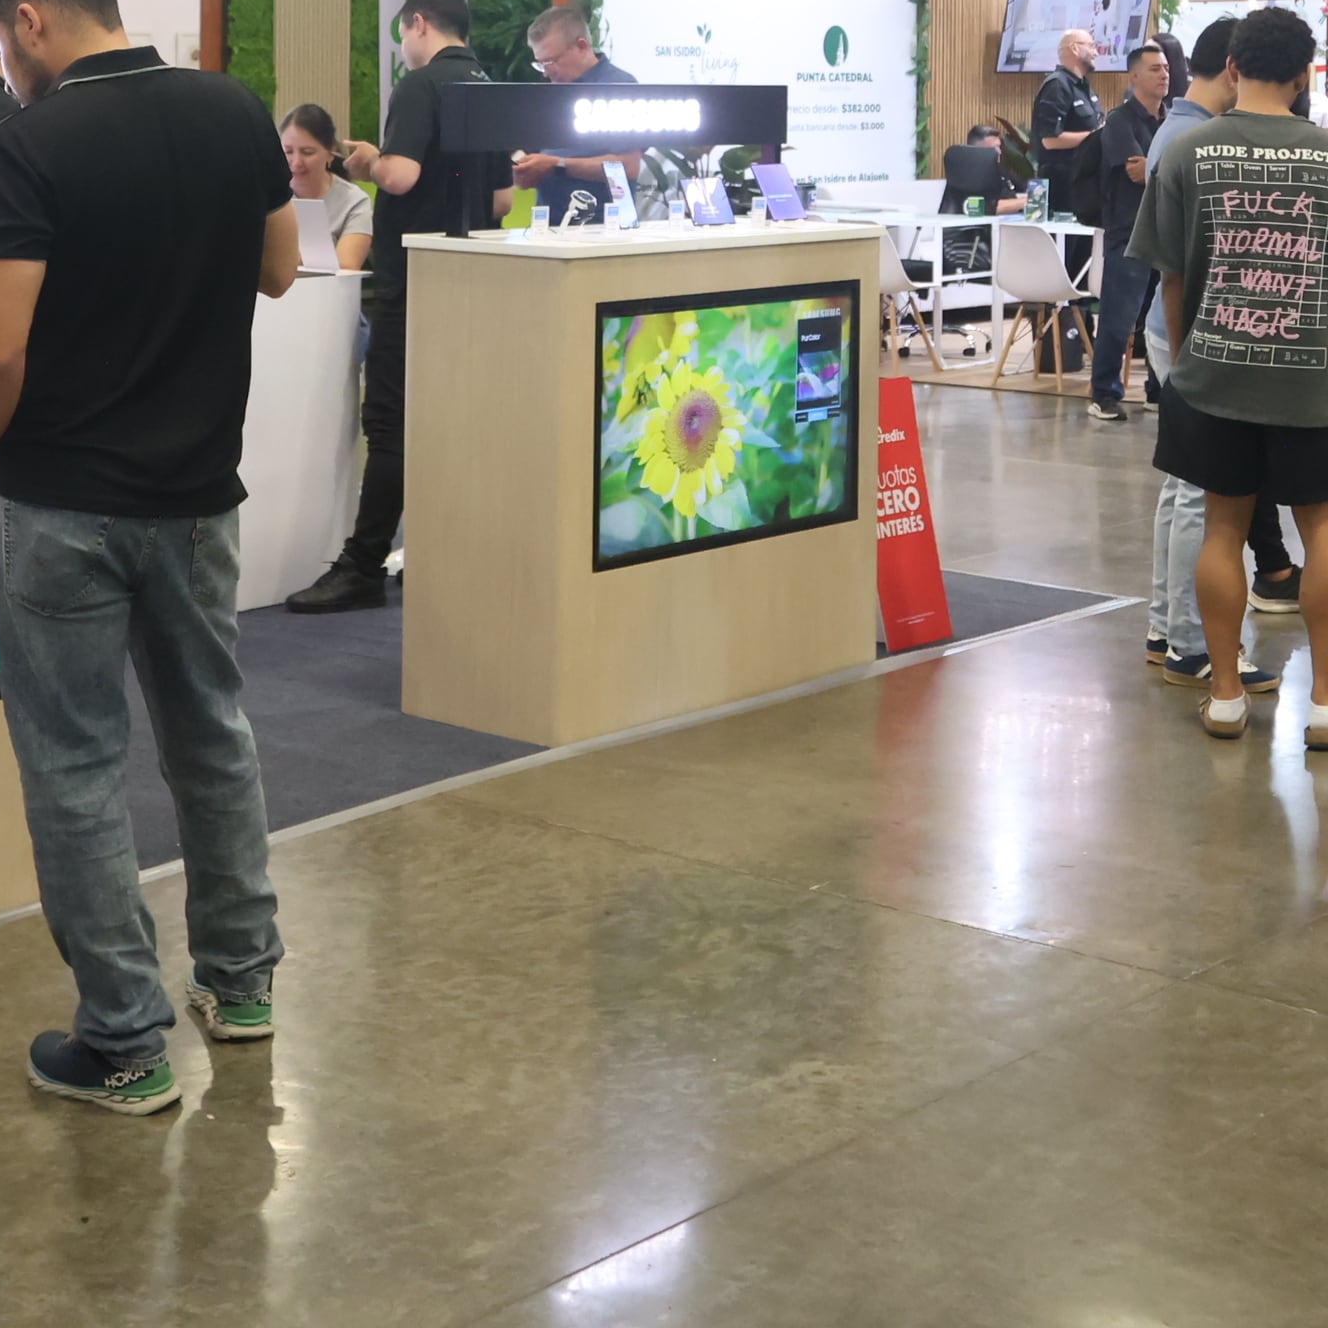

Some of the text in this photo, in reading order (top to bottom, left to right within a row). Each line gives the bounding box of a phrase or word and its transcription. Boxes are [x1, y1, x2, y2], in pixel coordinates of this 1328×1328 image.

[655, 46, 702, 58] SAN ISIDRO
[796, 72, 874, 83] PUNTA CATEDRAL
[841, 103, 881, 114] $382.000
[1195, 145, 1248, 159] NUDE
[808, 174, 823, 184] San
[859, 172, 890, 182] Alajuela
[1221, 189, 1315, 222] FUCK
[1214, 227, 1322, 262] NORMAL
[1213, 265, 1315, 300] I WANT
[1212, 304, 1300, 340] MAGIC
[104, 1070, 146, 1090] HOKA
